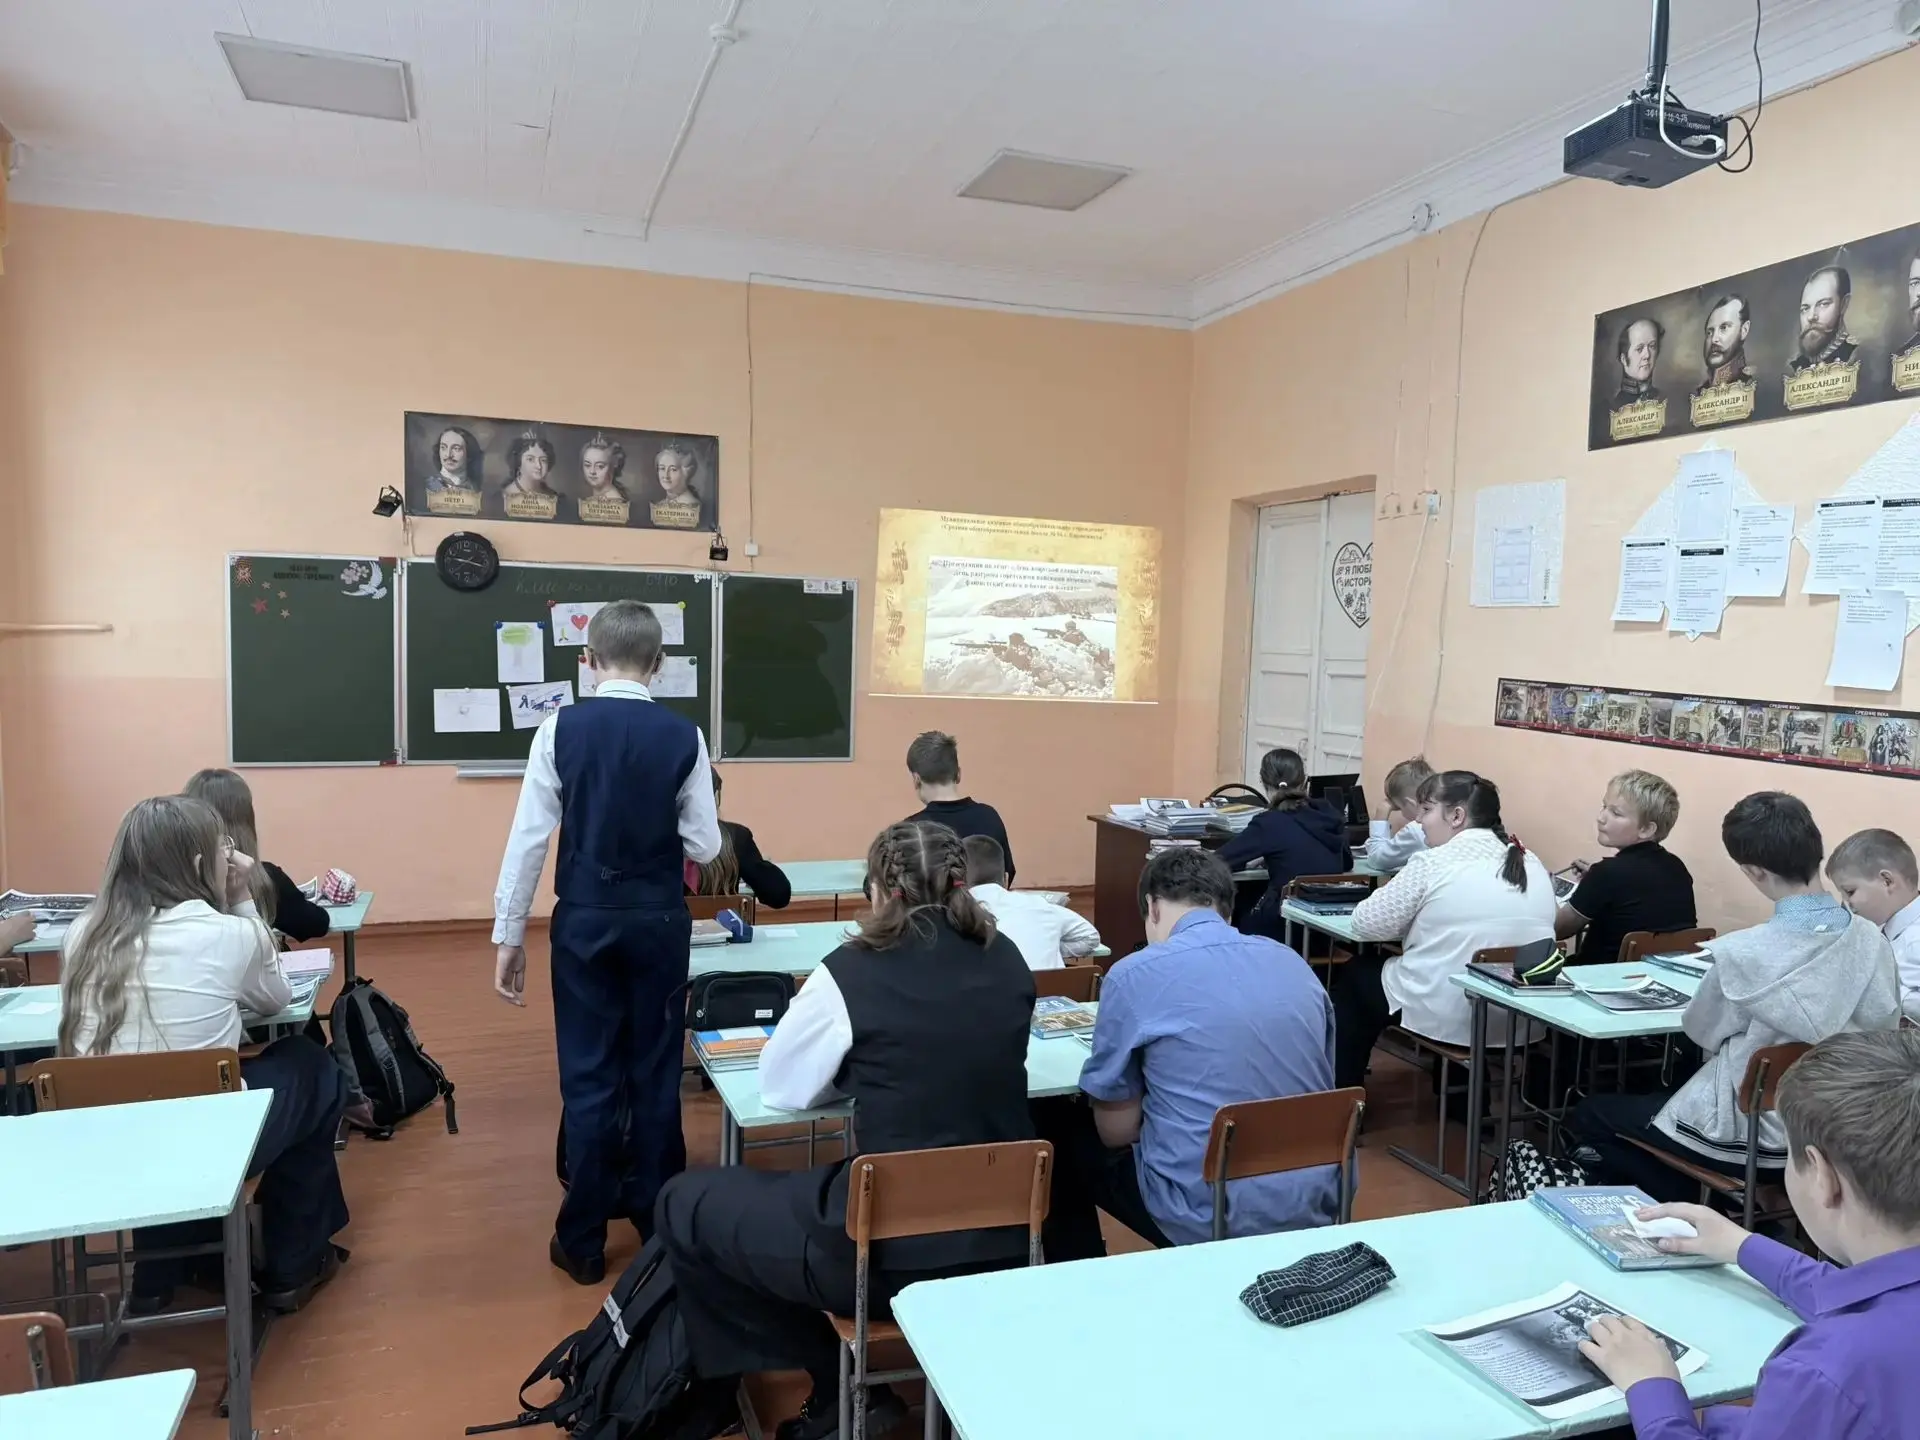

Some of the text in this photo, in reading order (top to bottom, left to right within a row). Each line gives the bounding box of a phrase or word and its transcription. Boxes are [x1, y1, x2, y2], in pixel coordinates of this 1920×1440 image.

[1790, 378, 1840, 393] АЛЕКСАНДР
[1697, 397, 1741, 411] АЛЕКСАНДР
[1345, 566, 1350, 575] Я
[1567, 1195, 1623, 1205] ИСТОРИЯ
